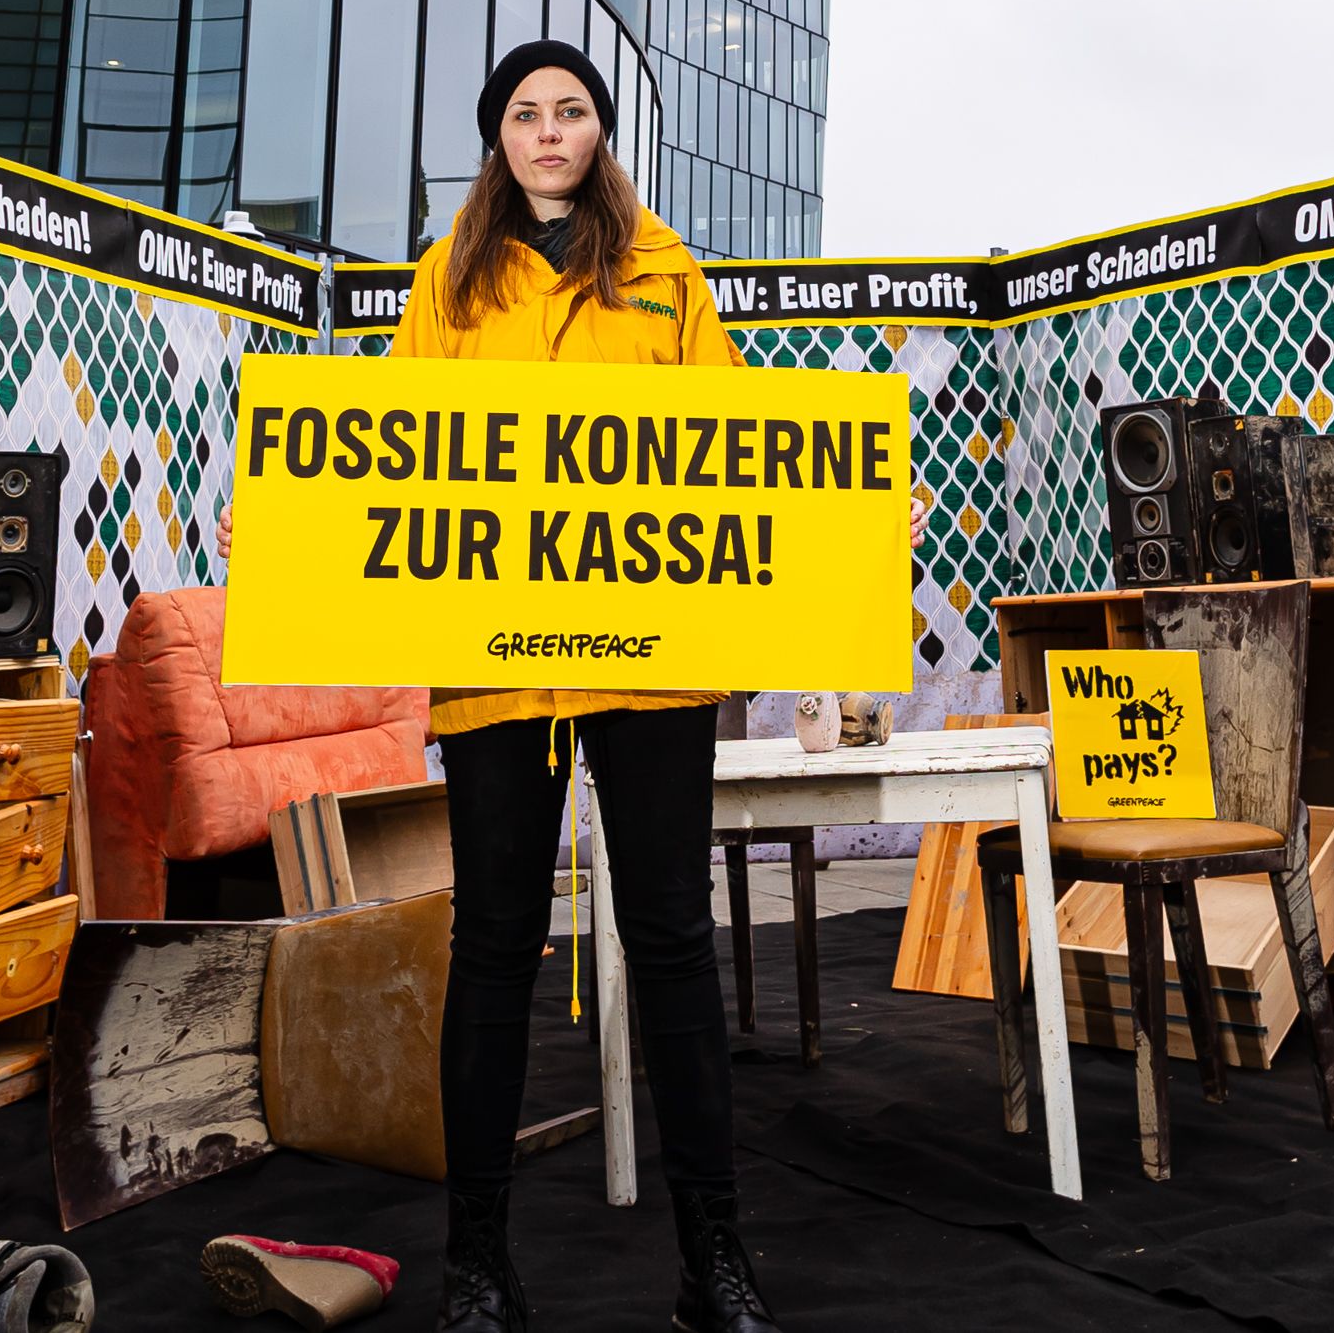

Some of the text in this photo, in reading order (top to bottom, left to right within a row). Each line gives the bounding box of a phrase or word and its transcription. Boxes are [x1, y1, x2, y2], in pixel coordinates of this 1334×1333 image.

[138, 228, 305, 321] OMV: Euer Profit,
[1006, 224, 1217, 308] unser Schaden!
[351, 272, 978, 317] uns MV: Euer Profit,
[628, 296, 676, 320] GREENPE
[248, 406, 892, 491] FOSSILE KONZERNE
[363, 506, 774, 586] ZUR KASSA!
[487, 632, 661, 661] GREENPEACE
[1061, 665, 1134, 700] Who
[1083, 744, 1178, 786] pays?
[1107, 797, 1166, 808] GREENPEACE
